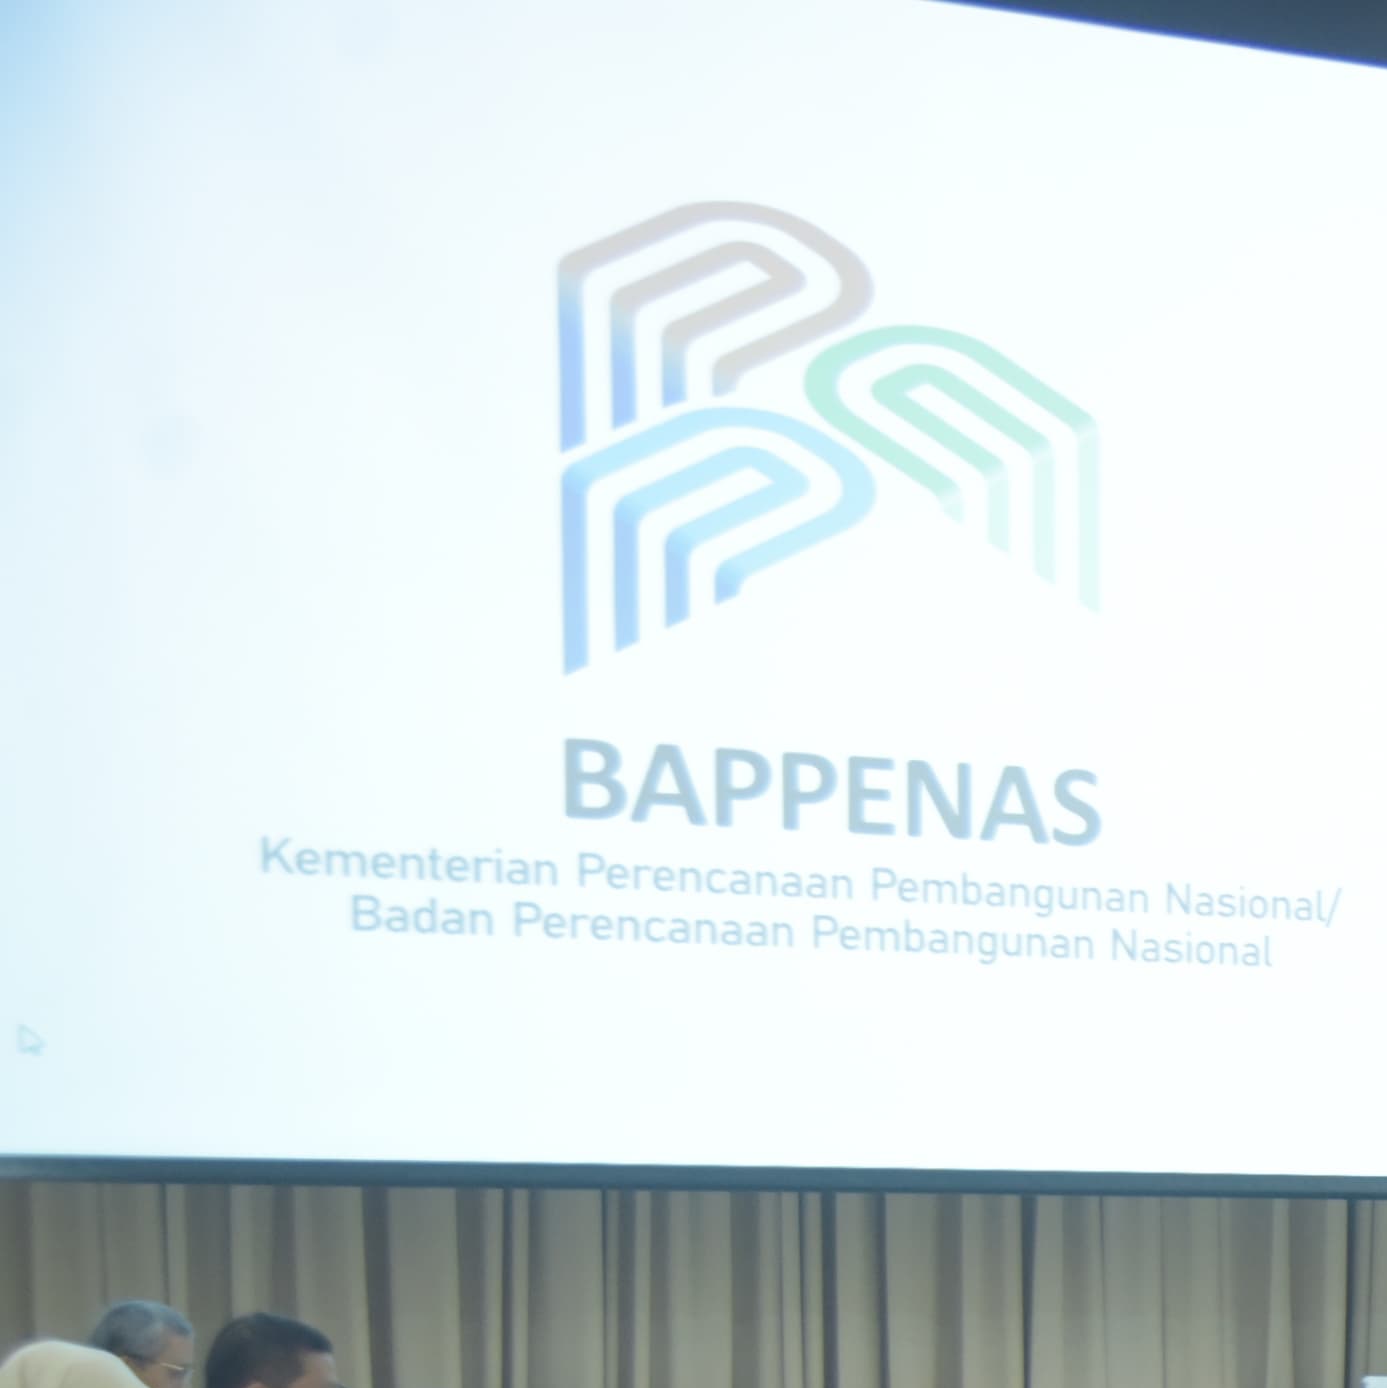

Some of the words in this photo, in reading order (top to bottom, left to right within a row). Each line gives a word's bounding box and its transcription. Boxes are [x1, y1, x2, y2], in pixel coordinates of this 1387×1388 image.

[562, 736, 1103, 847] BAPPENAS
[259, 834, 559, 887] Kementerian
[577, 851, 854, 901] Perencanaan
[871, 866, 1149, 918] Pembangunan
[1165, 881, 1342, 928] Nasional/
[350, 893, 495, 936] Badan
[513, 900, 795, 948] Perencanaan
[812, 913, 1095, 966] Pembangunan
[1111, 928, 1272, 967] Nasional
